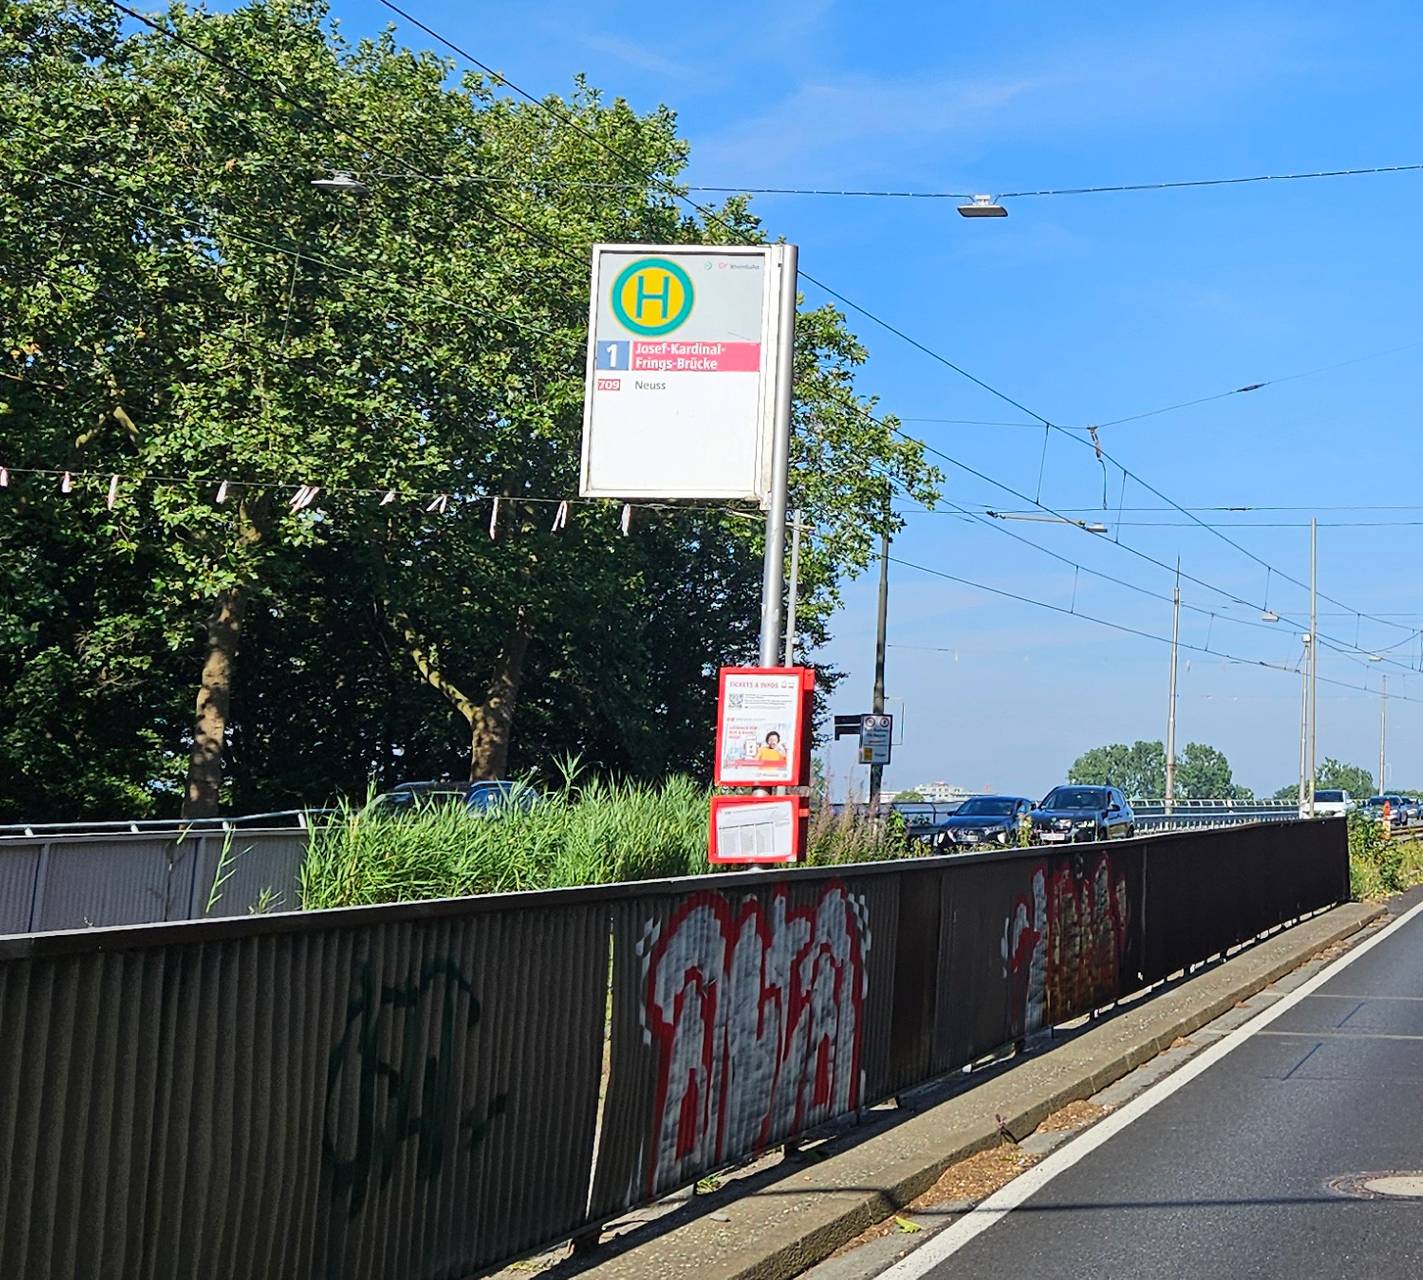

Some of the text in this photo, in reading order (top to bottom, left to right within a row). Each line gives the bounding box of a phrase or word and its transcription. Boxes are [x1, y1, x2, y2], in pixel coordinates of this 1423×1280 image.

[635, 275, 671, 319] H
[606, 343, 619, 368] 1
[635, 343, 725, 356] Josef-Kardinal-
[635, 356, 718, 371] Frings-Brücke
[598, 380, 620, 390] 709
[634, 380, 667, 390] Neuss
